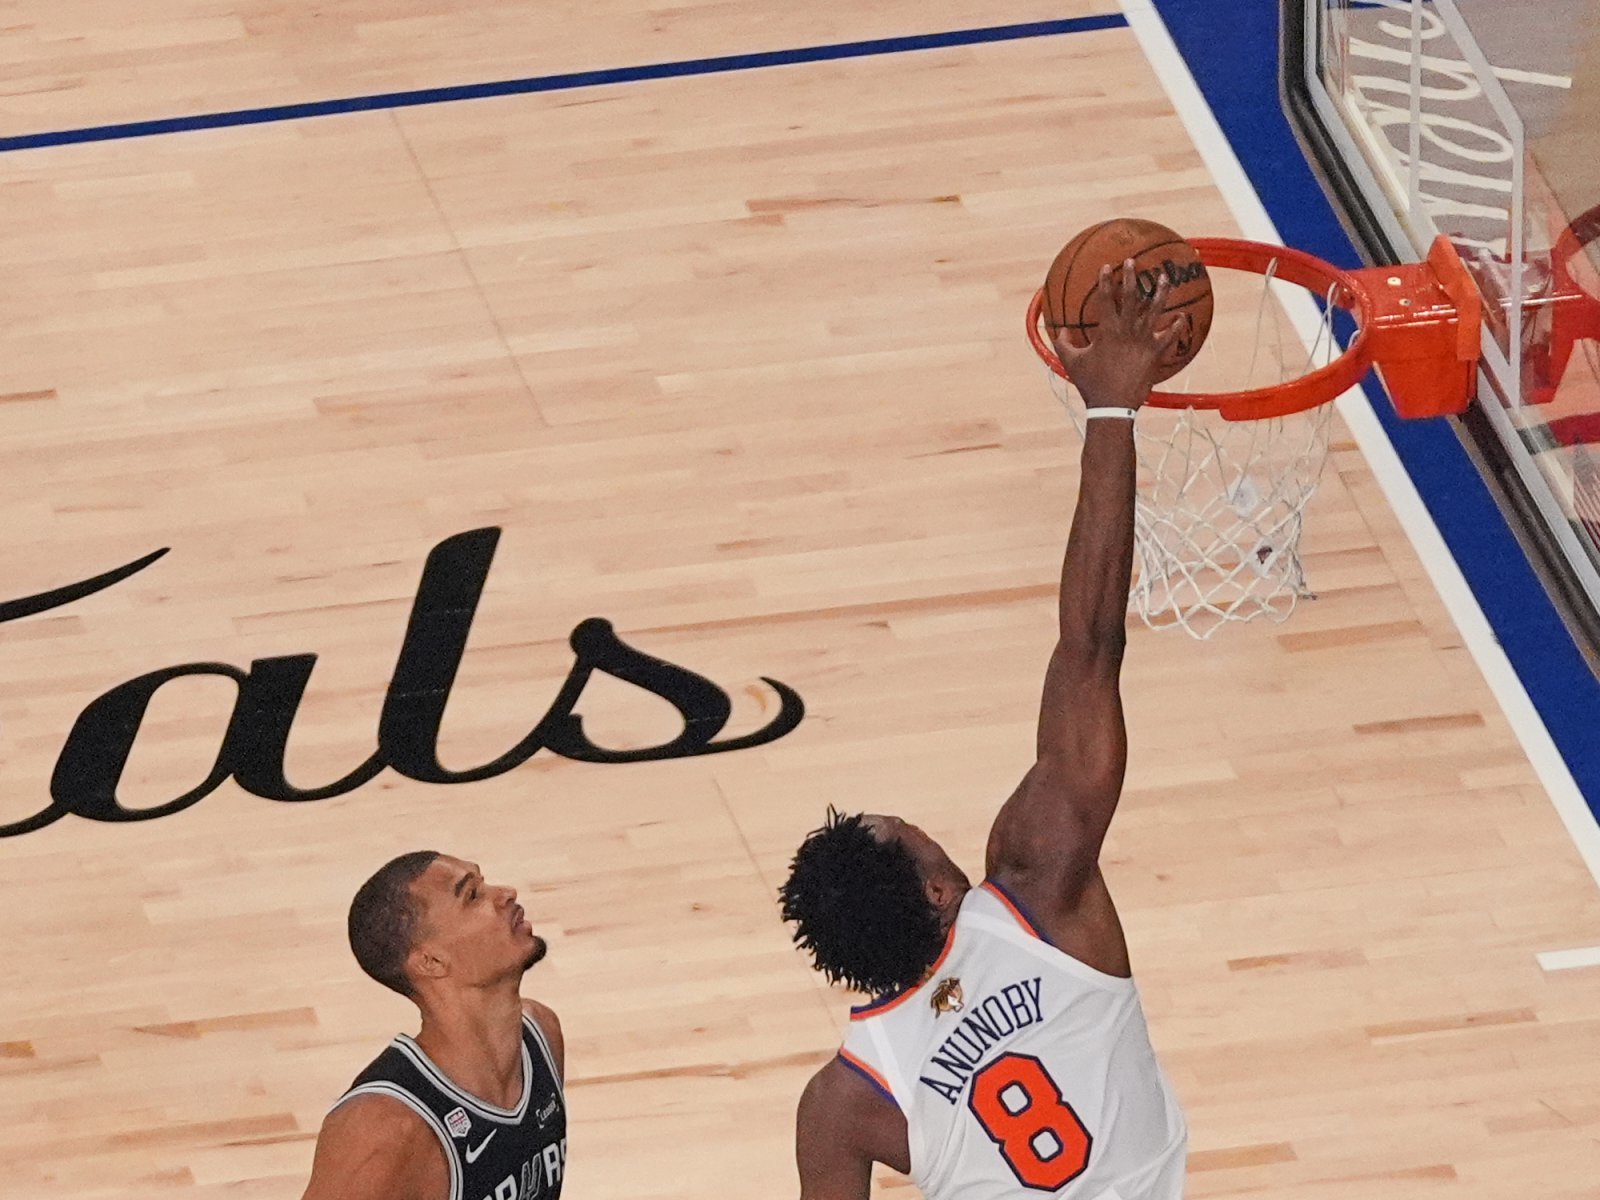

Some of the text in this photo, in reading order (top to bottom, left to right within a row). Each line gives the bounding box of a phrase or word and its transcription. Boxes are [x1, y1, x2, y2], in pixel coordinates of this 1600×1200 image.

[0, 526, 805, 838] als
[919, 977, 1044, 1105] ANUNOBY
[967, 1051, 1093, 1192] 8
